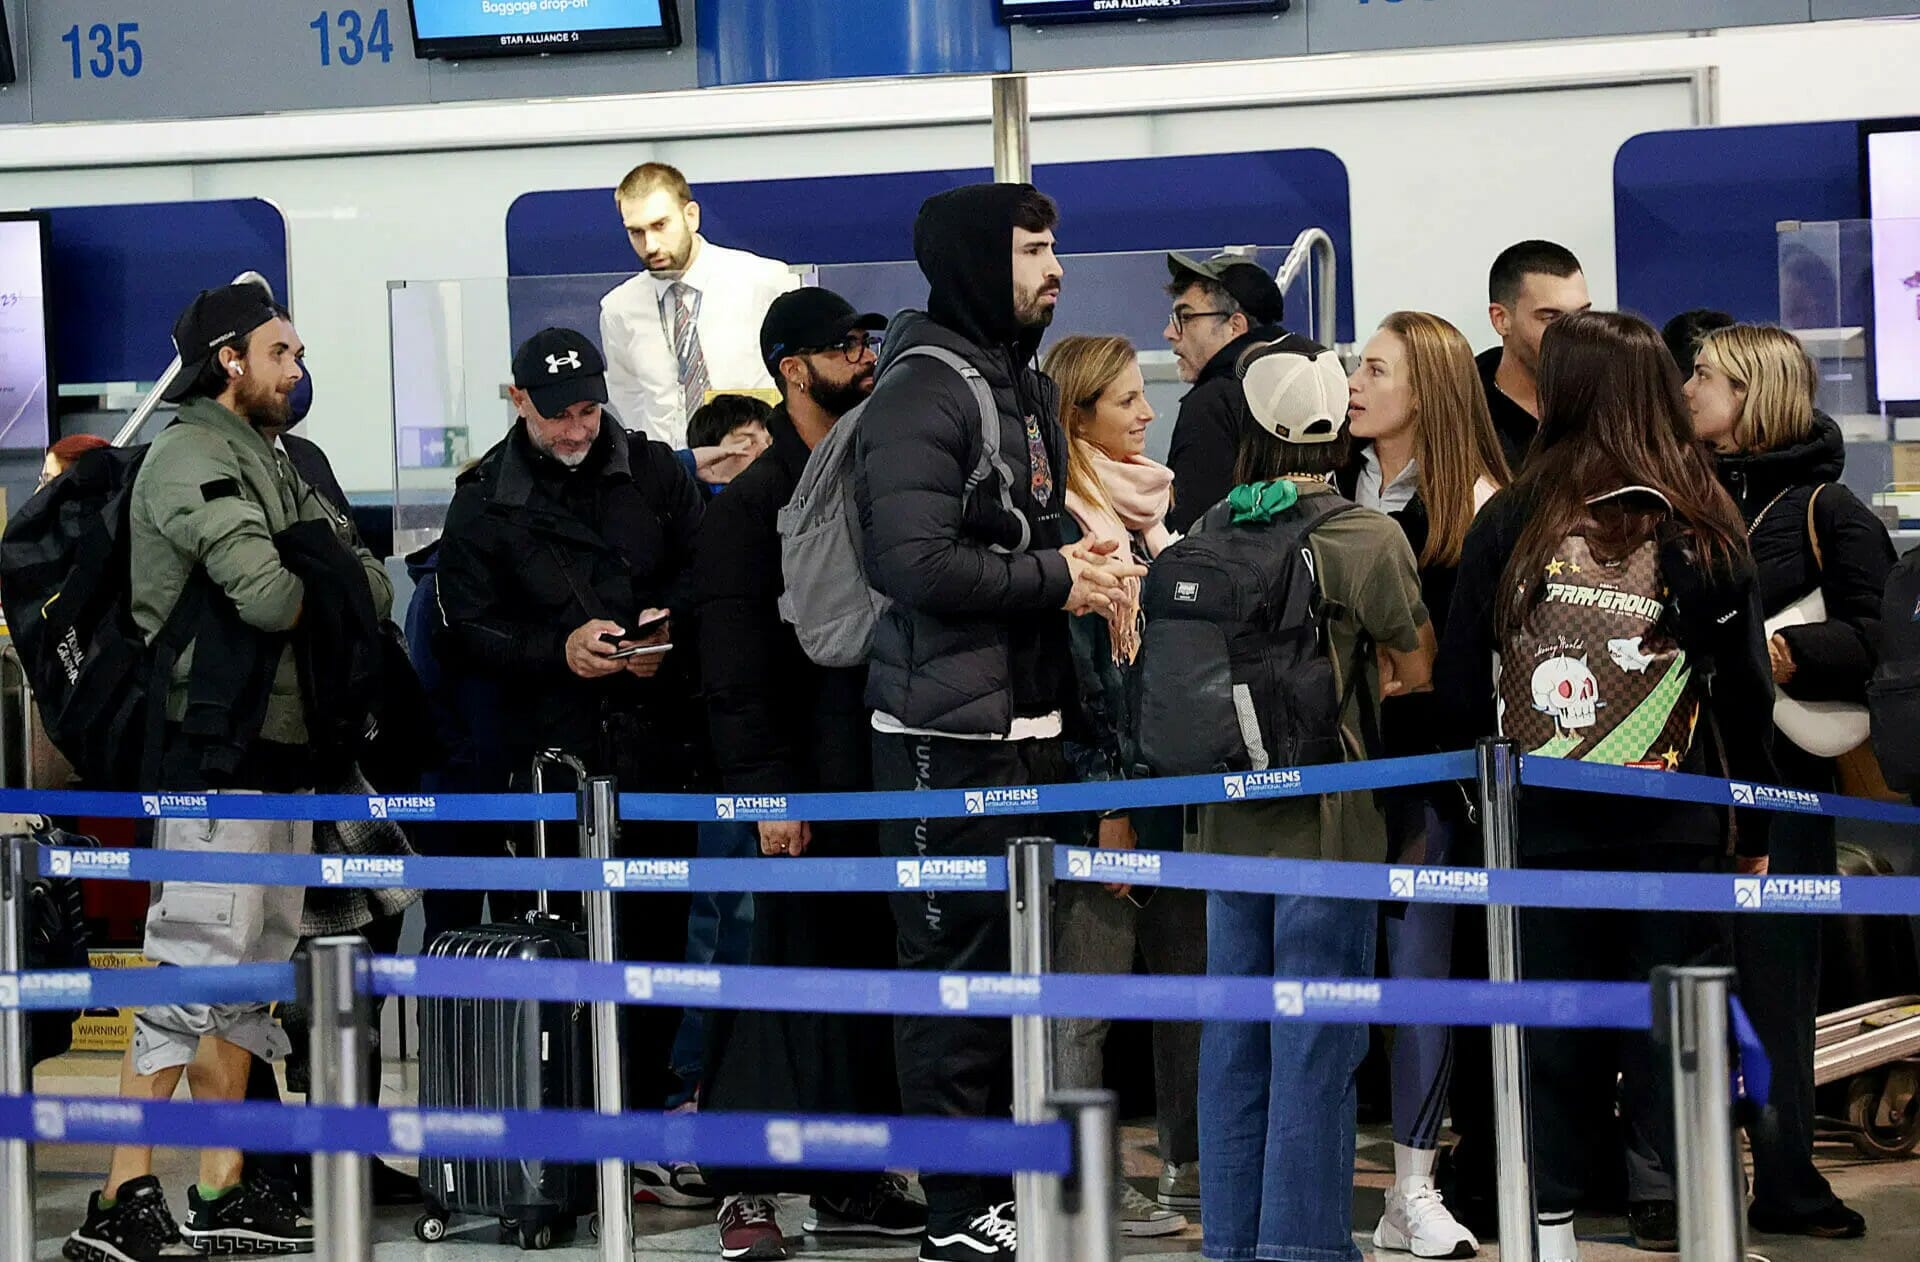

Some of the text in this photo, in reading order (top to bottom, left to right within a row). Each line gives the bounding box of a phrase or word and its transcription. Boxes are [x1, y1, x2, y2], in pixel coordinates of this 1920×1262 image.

[482, 0, 537, 15] Baggage
[309, 8, 394, 66] 134
[500, 33, 569, 45] STAR ALLIANCE
[61, 22, 143, 79] 135
[1246, 770, 1300, 786] ATHENS
[161, 795, 207, 806] ATHENS
[985, 788, 1039, 801] ATHENS
[1755, 786, 1820, 803] ATHENS
[387, 797, 435, 808] ATHENS
[736, 797, 787, 808] ATHENS
[72, 851, 130, 865] ATHENS
[343, 858, 404, 872] ATHENS
[1093, 852, 1161, 868] ATHENS
[626, 860, 689, 875] ATHENS
[921, 859, 987, 874] ATHENS
[1416, 869, 1489, 887] ATHENS
[1763, 879, 1842, 895] ATHENS
[79, 1025, 128, 1036] WARNING!
